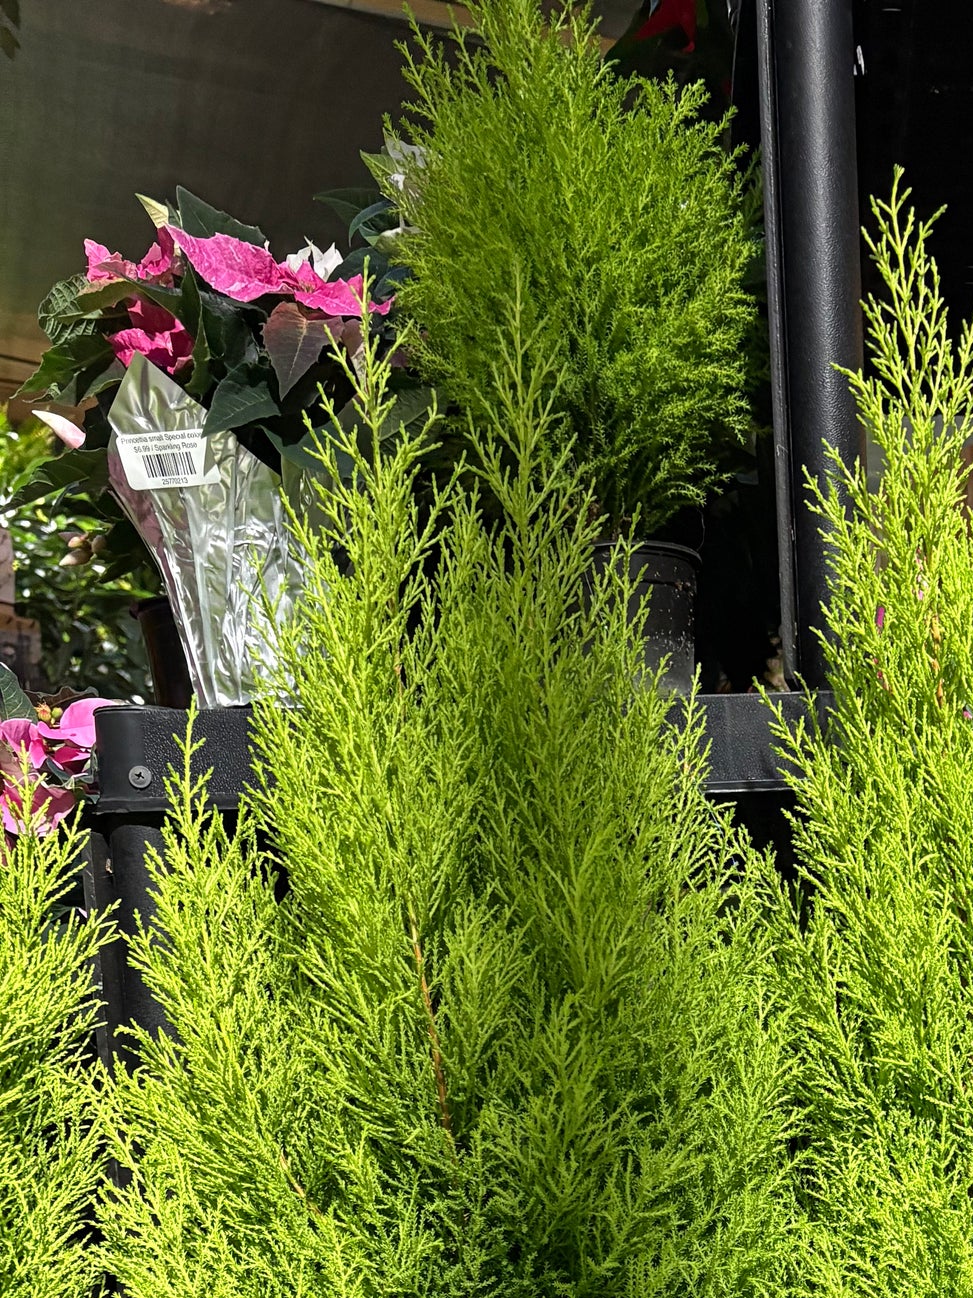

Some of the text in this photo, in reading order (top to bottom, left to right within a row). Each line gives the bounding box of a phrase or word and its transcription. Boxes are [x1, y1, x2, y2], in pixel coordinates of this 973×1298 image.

[148, 434, 164, 442] small
[164, 432, 186, 442] Special
[154, 443, 181, 452] Sparkling
[181, 441, 197, 449] Rose
